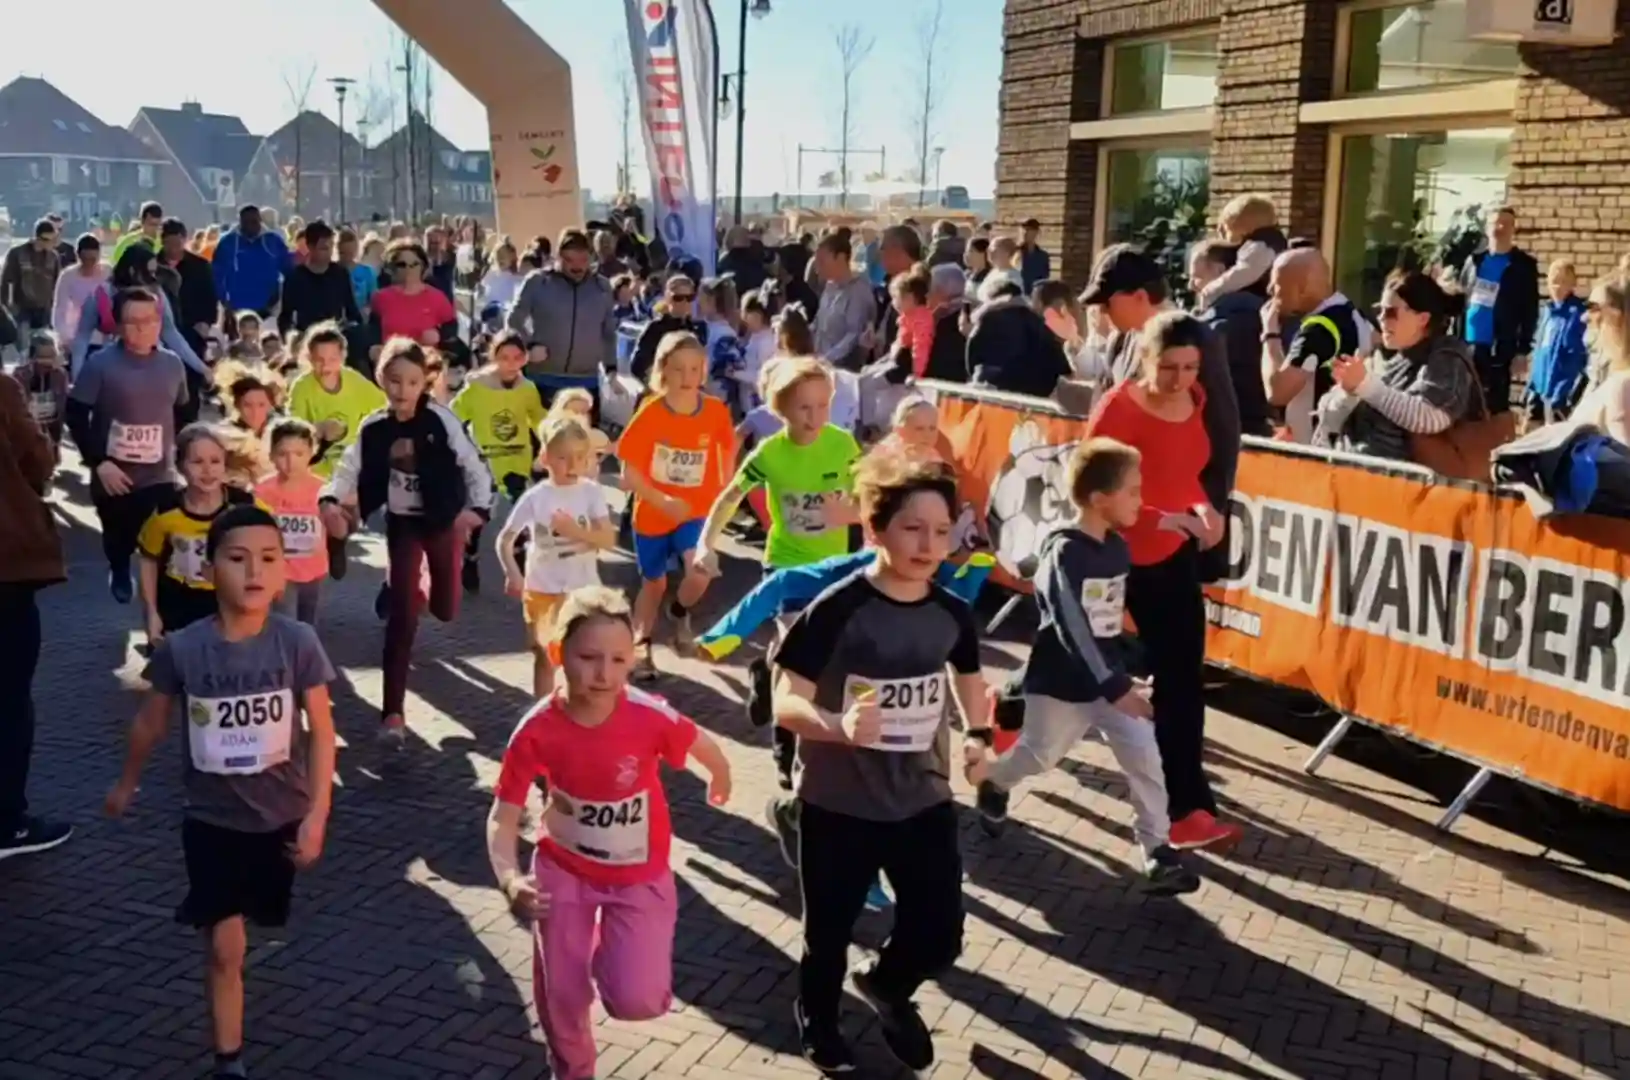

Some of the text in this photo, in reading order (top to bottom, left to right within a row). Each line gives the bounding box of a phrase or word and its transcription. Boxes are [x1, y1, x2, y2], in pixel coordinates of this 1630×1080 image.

[1338, 523, 1464, 647] VAN
[1478, 558, 1630, 697] BER
[880, 678, 939, 709] 2012
[218, 695, 283, 728] 2050
[1436, 675, 1630, 760] www.vriendenva
[578, 797, 642, 828] 2042
